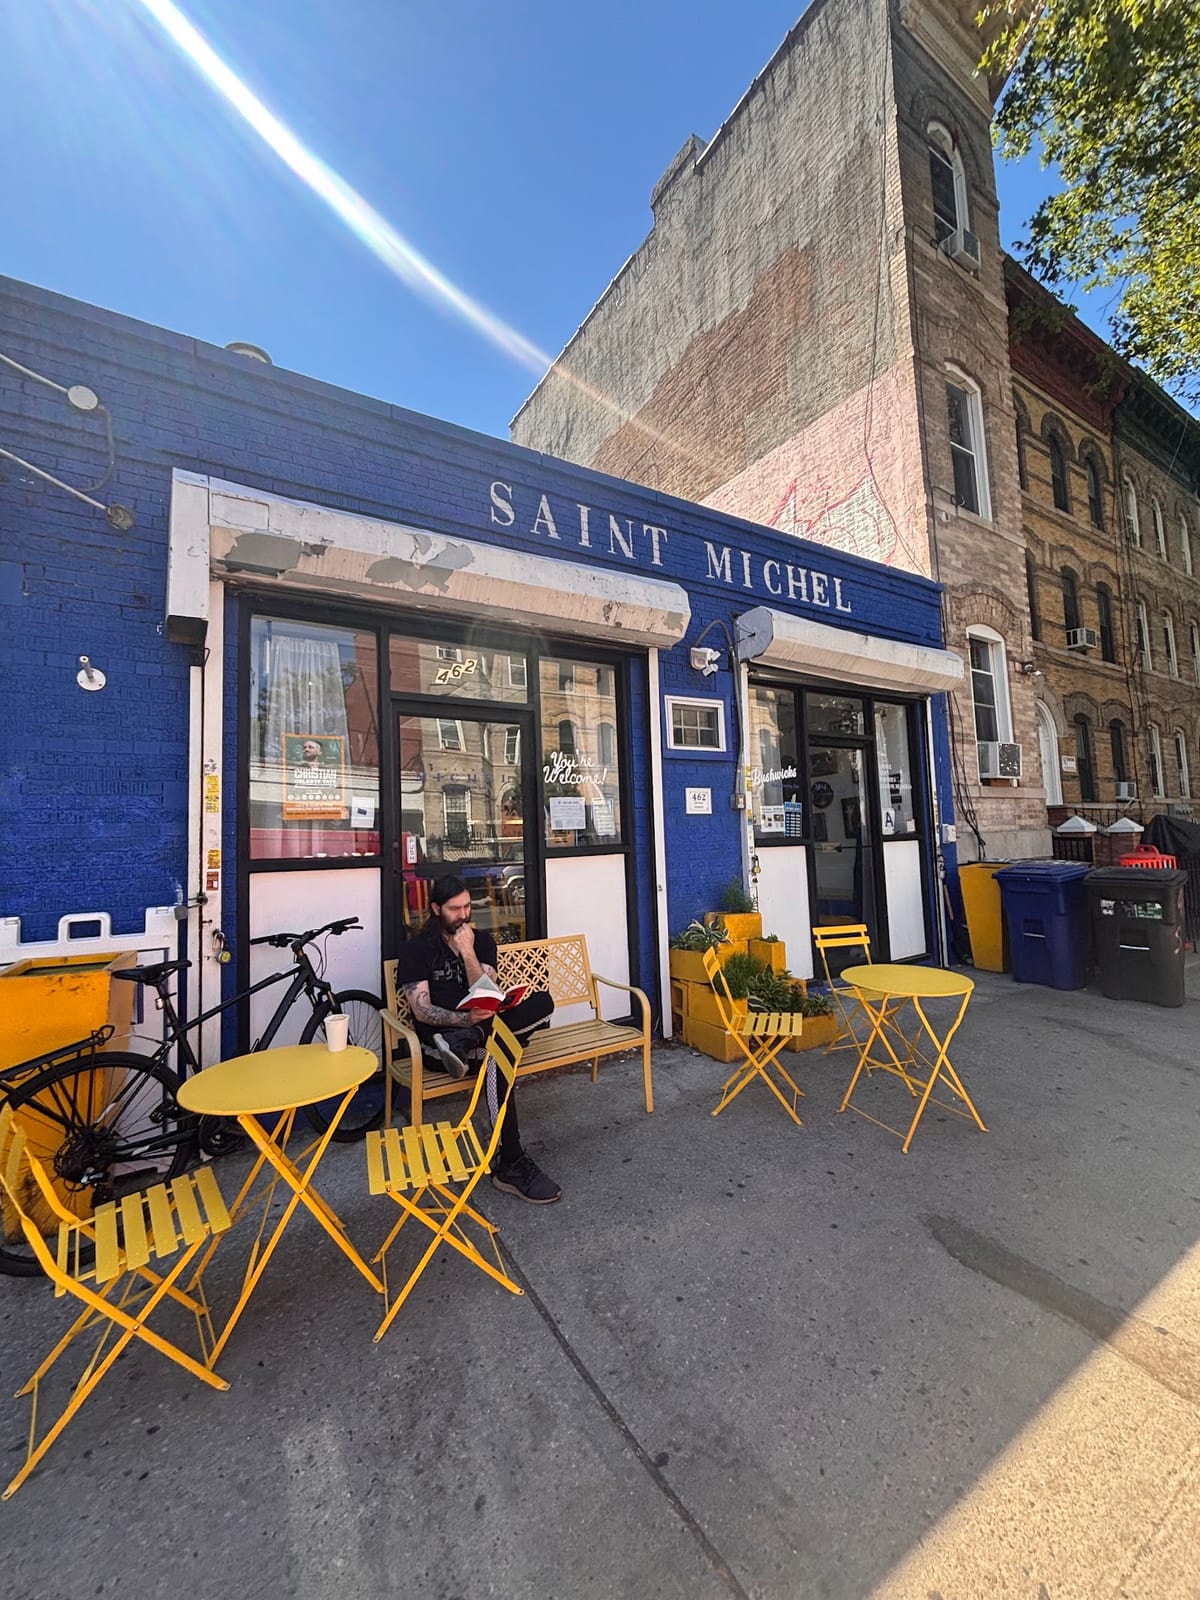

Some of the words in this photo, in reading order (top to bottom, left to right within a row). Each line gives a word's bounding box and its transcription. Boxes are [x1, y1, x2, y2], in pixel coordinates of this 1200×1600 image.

[490, 481, 669, 567] SAINT
[703, 541, 852, 613] MICHEL
[437, 660, 475, 683] 462
[543, 765, 607, 785] Welcome!
[750, 764, 798, 787] Bushwicks
[692, 792, 707, 801] 462
[884, 810, 894, 828] A
